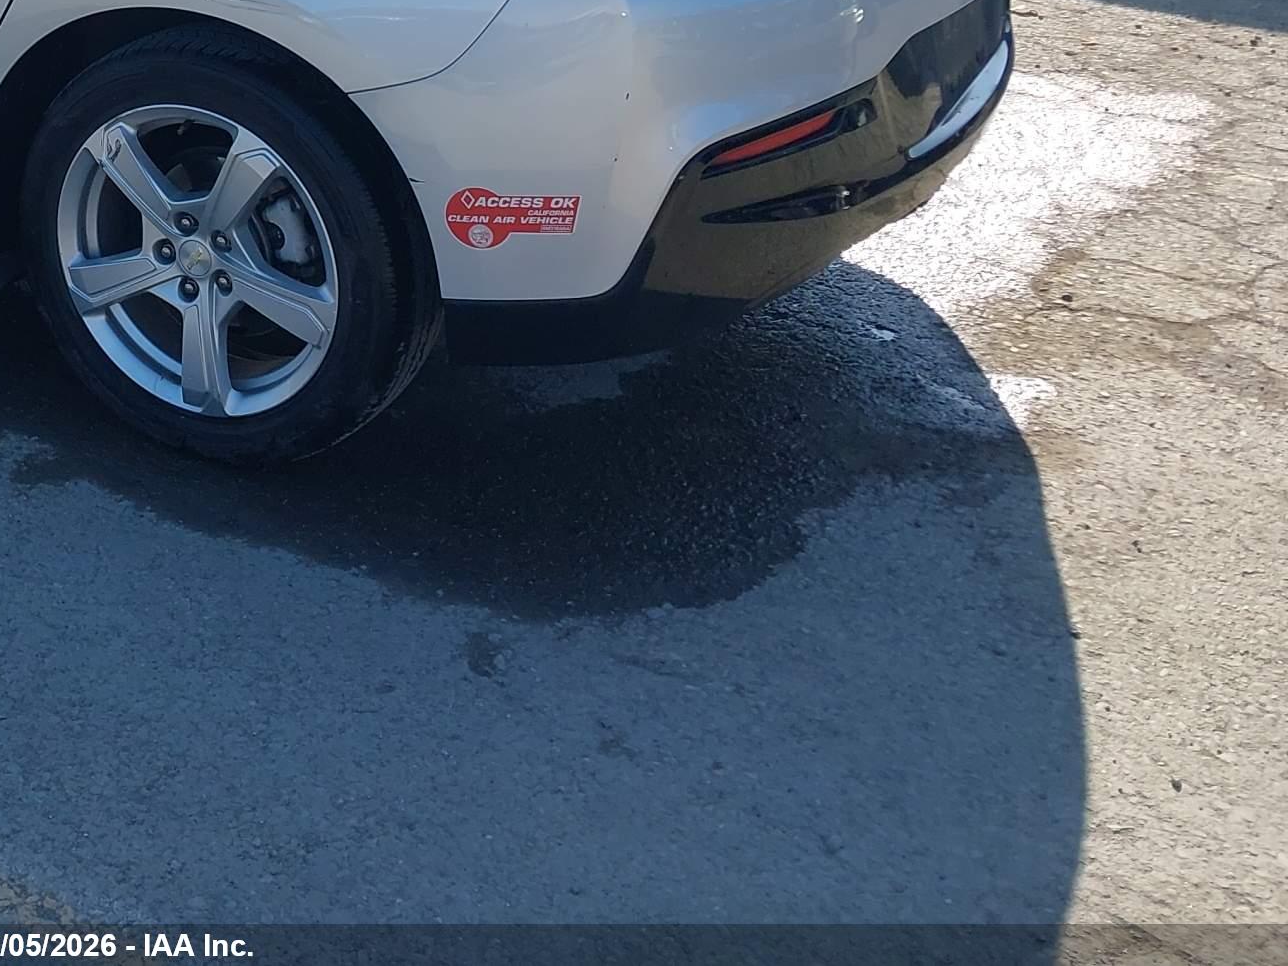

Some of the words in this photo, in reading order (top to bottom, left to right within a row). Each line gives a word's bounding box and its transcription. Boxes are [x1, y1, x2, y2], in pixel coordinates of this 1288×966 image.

[474, 196, 544, 208] ACCESS
[550, 197, 577, 209] OK
[447, 214, 490, 224] CLEAN
[493, 216, 516, 224] AIR
[520, 216, 574, 225] VEHICLE
